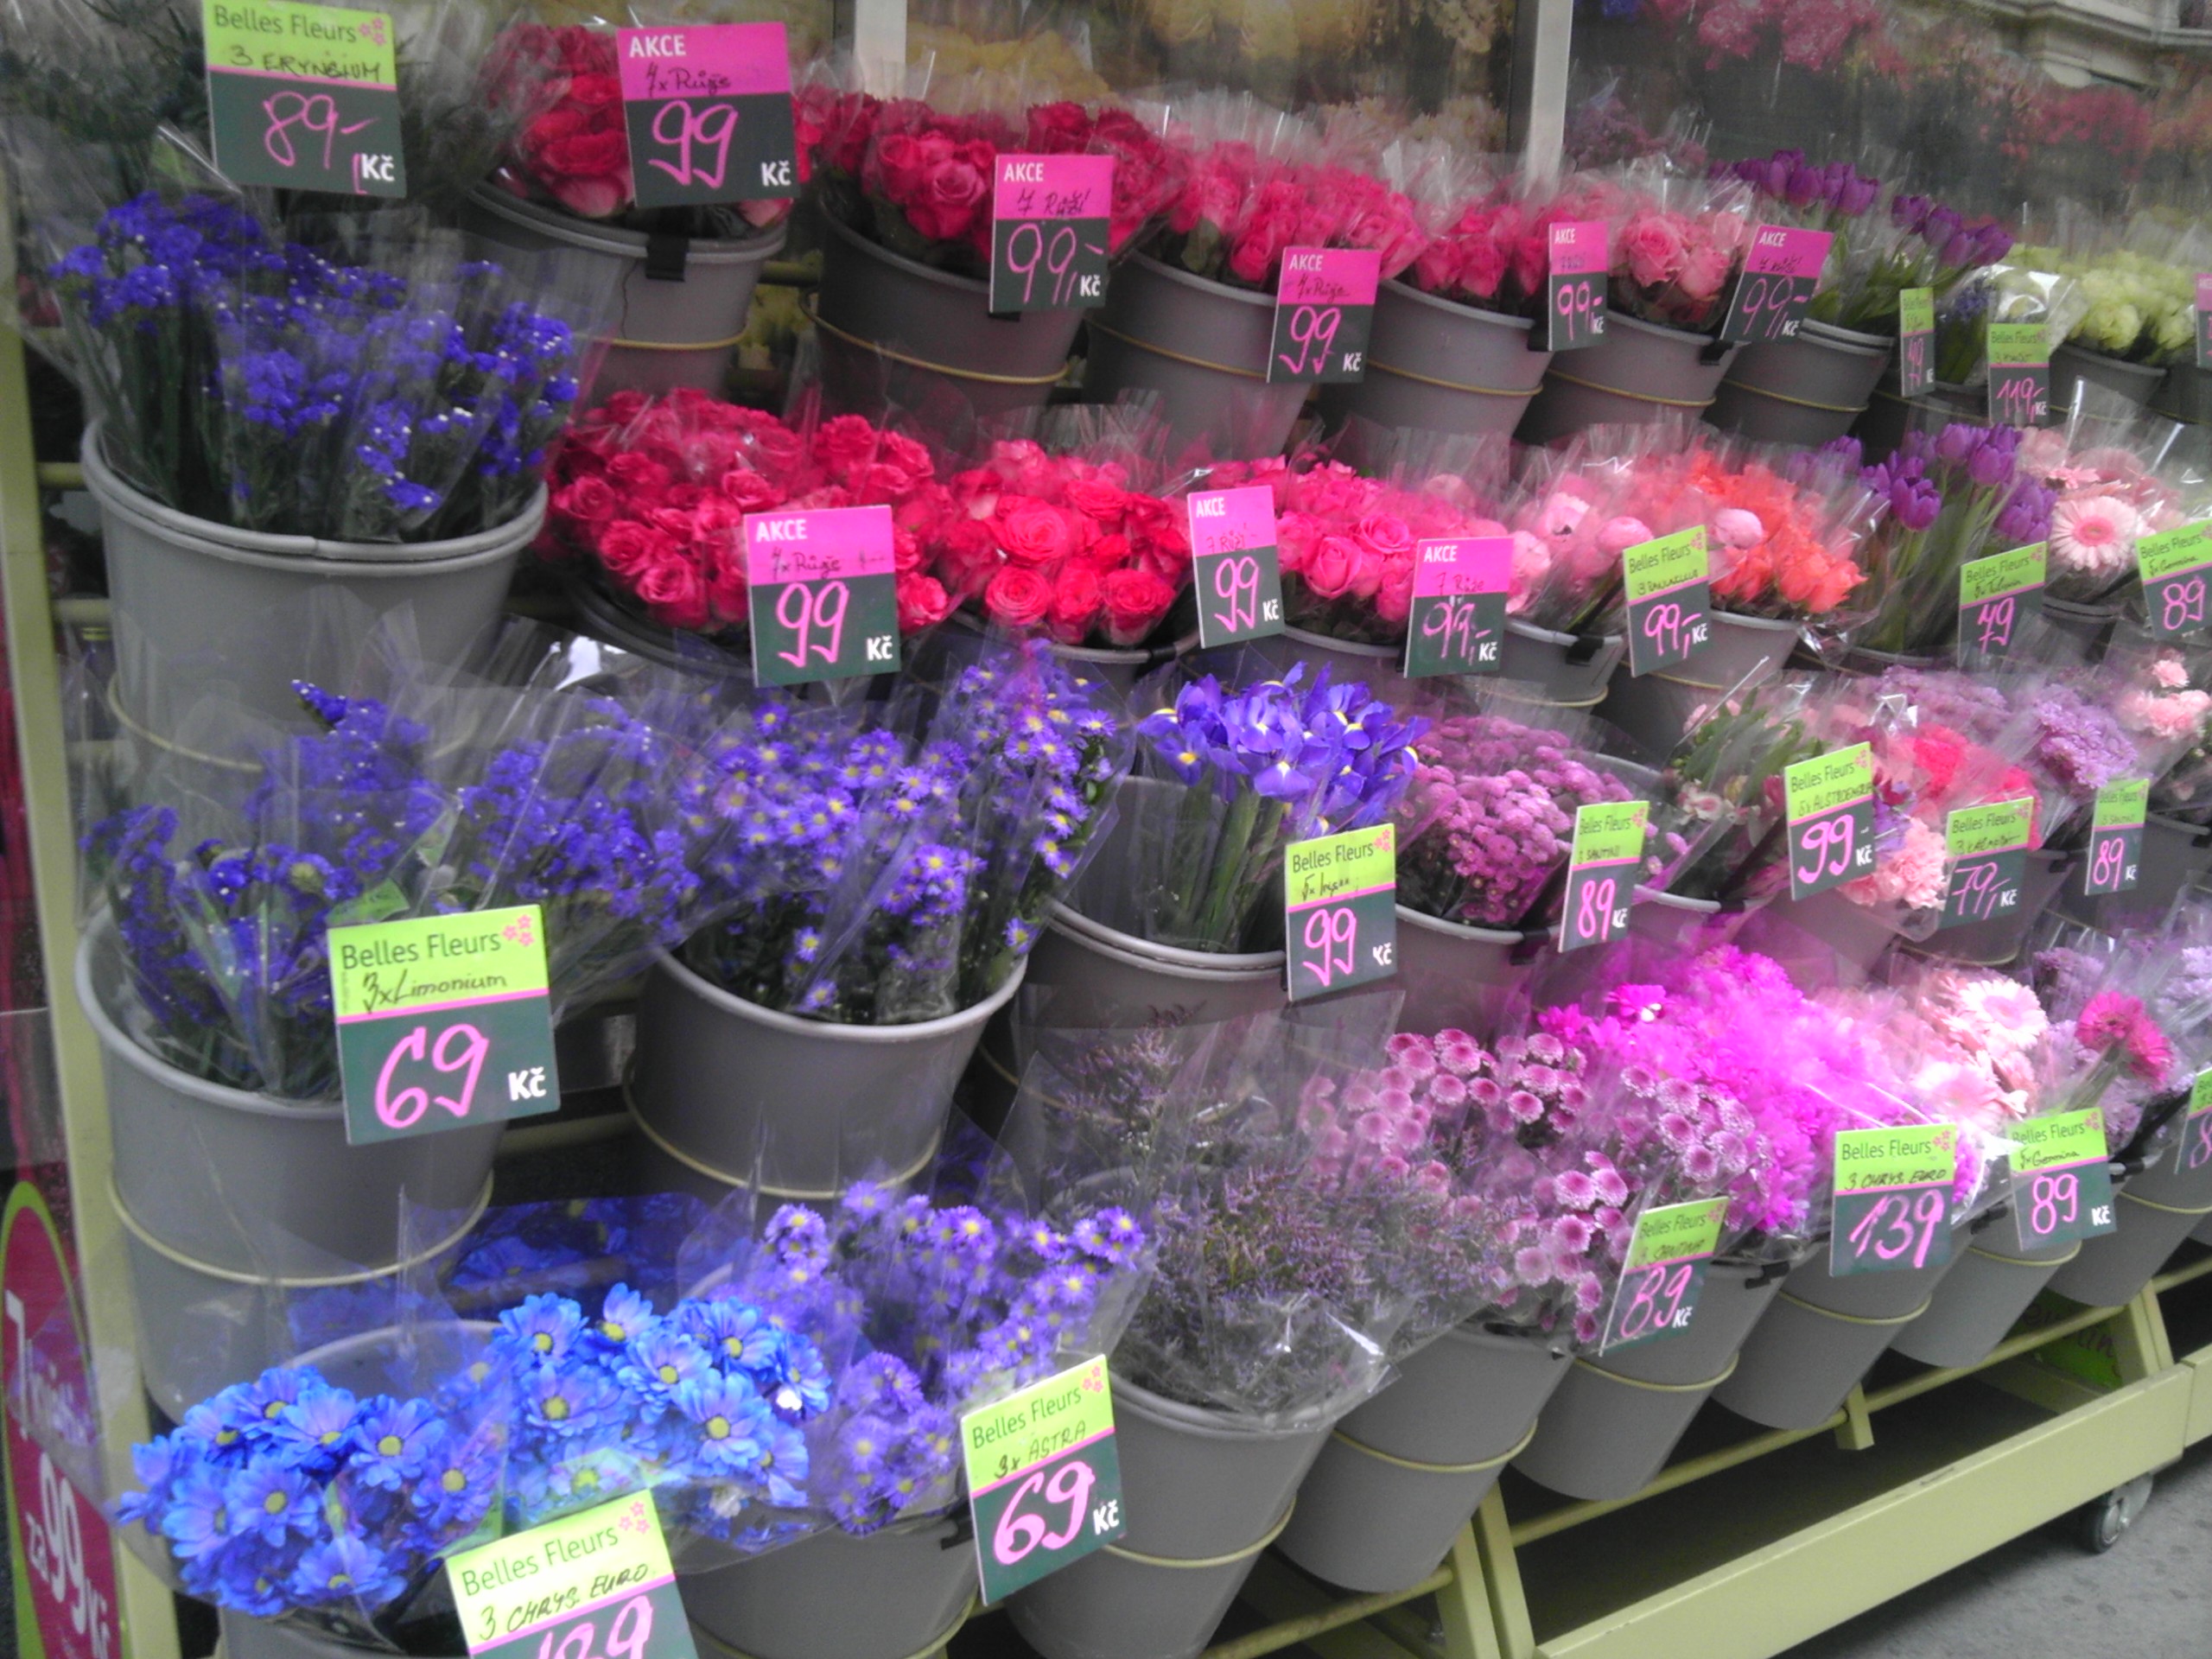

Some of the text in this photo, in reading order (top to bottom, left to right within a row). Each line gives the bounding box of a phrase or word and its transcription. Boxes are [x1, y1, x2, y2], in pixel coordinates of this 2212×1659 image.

[213, 3, 357, 44] Belles Fleurs
[230, 44, 253, 66] 3
[629, 34, 687, 58] AKCE
[648, 99, 791, 188] 99 Kč
[360, 153, 396, 182] Kč
[1003, 162, 1044, 182] AKCE
[1554, 227, 1576, 245] AKCE
[1758, 231, 1788, 248] AKCE
[1288, 253, 1324, 272] AKCE
[1079, 273, 1102, 297] Kč
[1278, 305, 1363, 375] 99 Kč
[1782, 319, 1801, 337] Kč
[1195, 497, 1226, 518] AKCE
[755, 518, 808, 543] AKCE
[1423, 544, 1459, 563] AKCE
[1629, 543, 1691, 575] Belles Fleurs
[2139, 534, 2202, 559] Belles Fleurs
[1966, 556, 2030, 583] Belles Fleurs
[1214, 556, 1281, 633] 99 Kč
[2162, 580, 2206, 631] 89
[776, 580, 893, 669] 99 Kč
[1691, 622, 1708, 645] Kč
[1478, 641, 1498, 662] Kč
[1790, 762, 1855, 793] Belles Fleurs
[1579, 814, 1631, 836] Belles Fleurs
[1951, 811, 2017, 835] Belles Fleurs
[1292, 842, 1374, 874] Belles Fleurs
[1796, 813, 1873, 884] 99 Kč
[2093, 836, 2125, 890] 89
[1578, 878, 1629, 942] 89 Kč
[2000, 888, 2018, 907] Kč
[340, 932, 502, 970] Belles Fleurs
[1302, 907, 1392, 987] 99 Kč
[374, 1023, 547, 1129] 69 Kč
[1841, 1138, 1932, 1161] Belles Fleurs
[2012, 1122, 2086, 1146] Belles Fleurs
[1844, 1172, 1857, 1192] 3
[2031, 1173, 2112, 1234] 89 Kč
[1640, 1212, 1707, 1238] Belles Fleurs
[1848, 1188, 1945, 1269] 139
[1620, 1264, 1694, 1338] 89 Kč
[971, 1387, 1082, 1450] Belles Fleurs
[1027, 1420, 1086, 1463] ASTRA
[993, 1460, 1120, 1566] 69 Kč
[40, 1451, 87, 1635] 99
[461, 1527, 619, 1597] Belles Fleurs
[479, 1605, 497, 1642] 3
